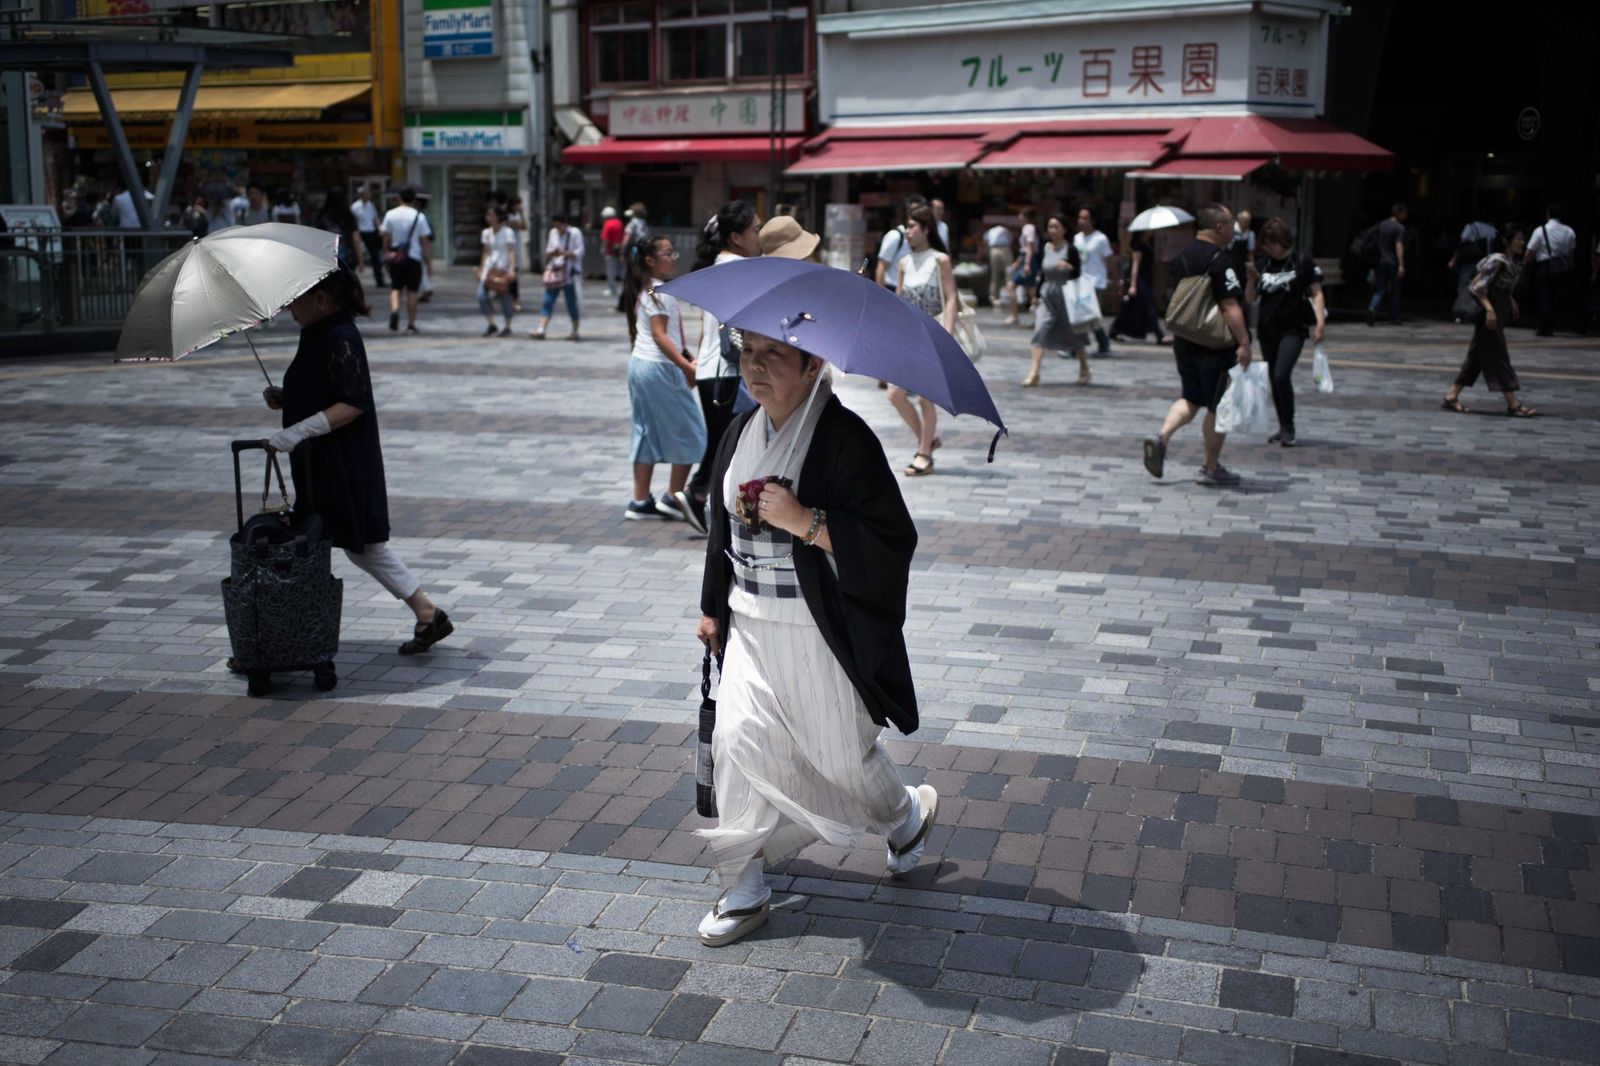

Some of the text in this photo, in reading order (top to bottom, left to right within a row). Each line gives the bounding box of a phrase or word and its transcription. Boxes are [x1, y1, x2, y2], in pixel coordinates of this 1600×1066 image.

[425, 11, 491, 33] FamilyMart
[962, 42, 1219, 99] フルーツ 百果園
[1256, 66, 1309, 98] 百果園
[439, 130, 502, 149] FamilyMart
